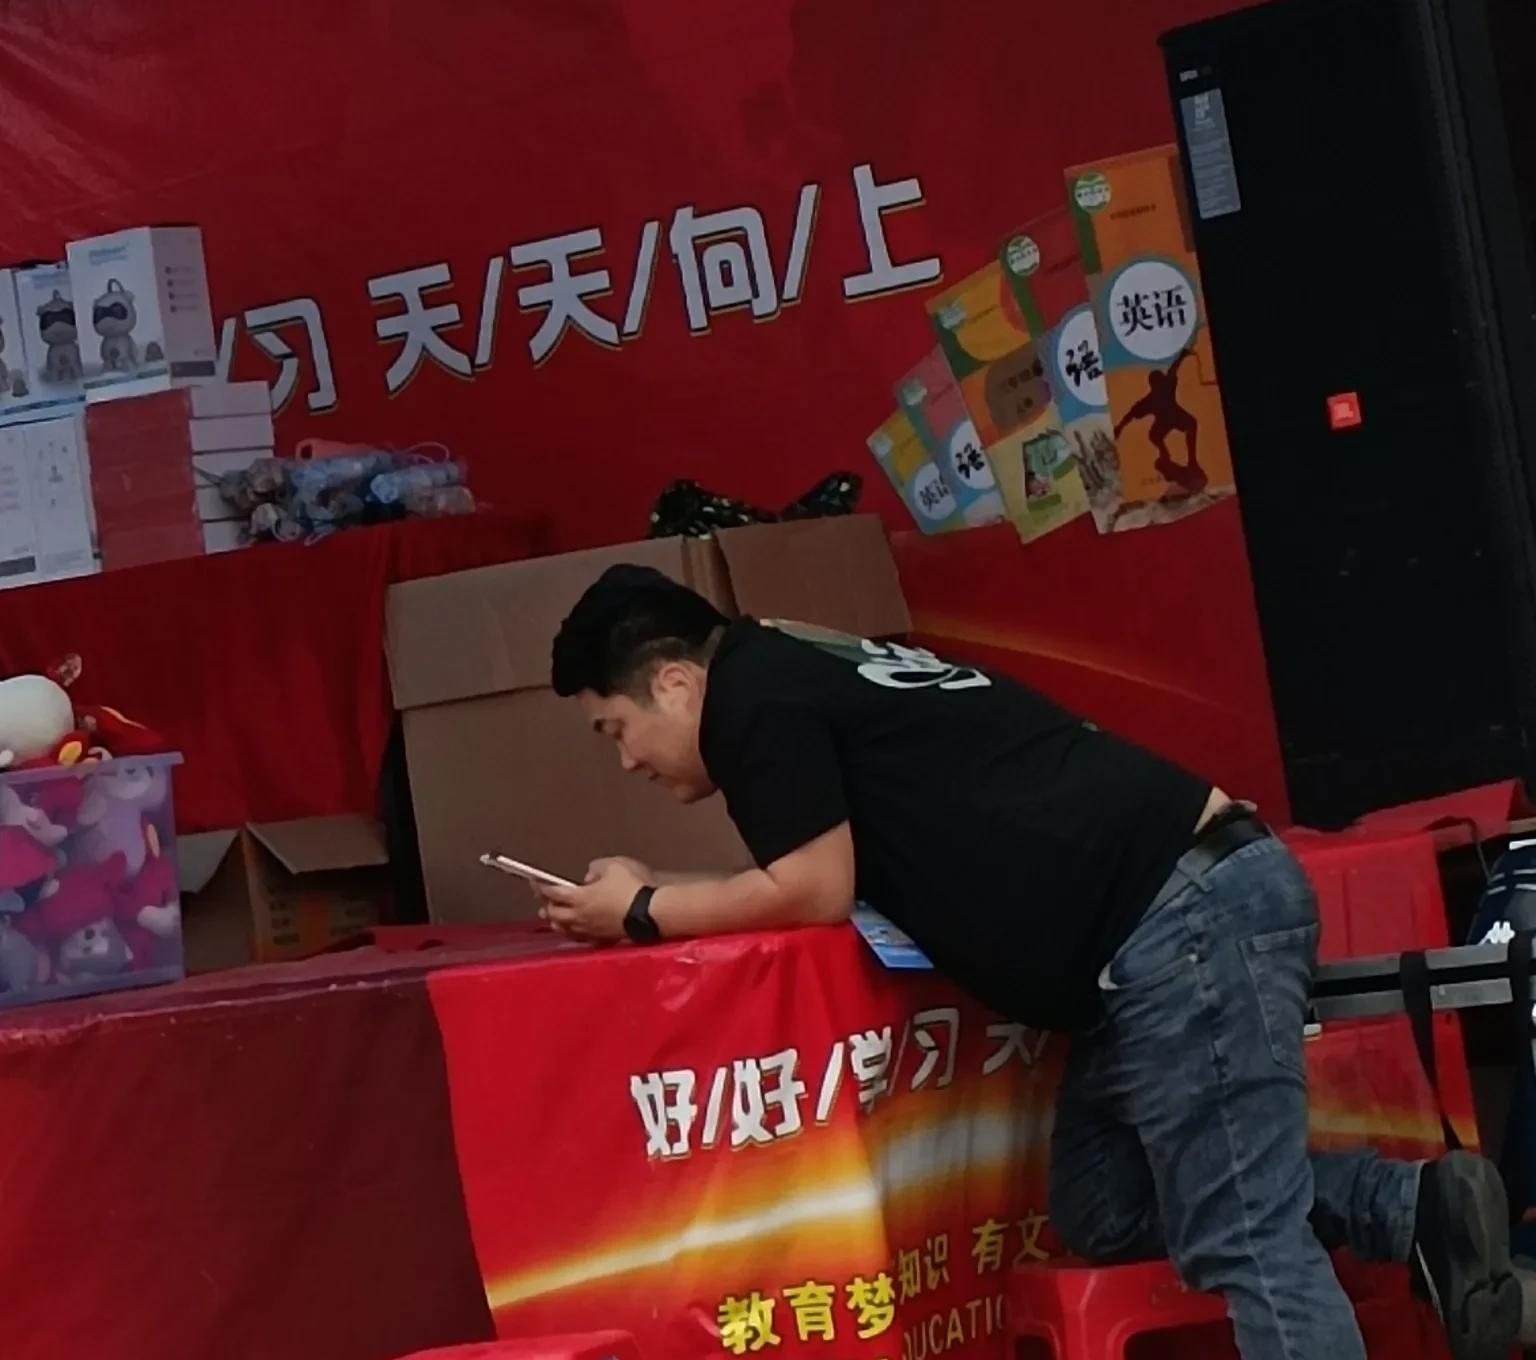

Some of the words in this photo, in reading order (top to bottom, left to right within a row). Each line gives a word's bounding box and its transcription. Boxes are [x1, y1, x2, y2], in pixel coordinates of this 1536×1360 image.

[1116, 285, 1187, 337] 英语
[717, 1272, 897, 1354] 教育梦
[898, 1233, 950, 1305] 知识
